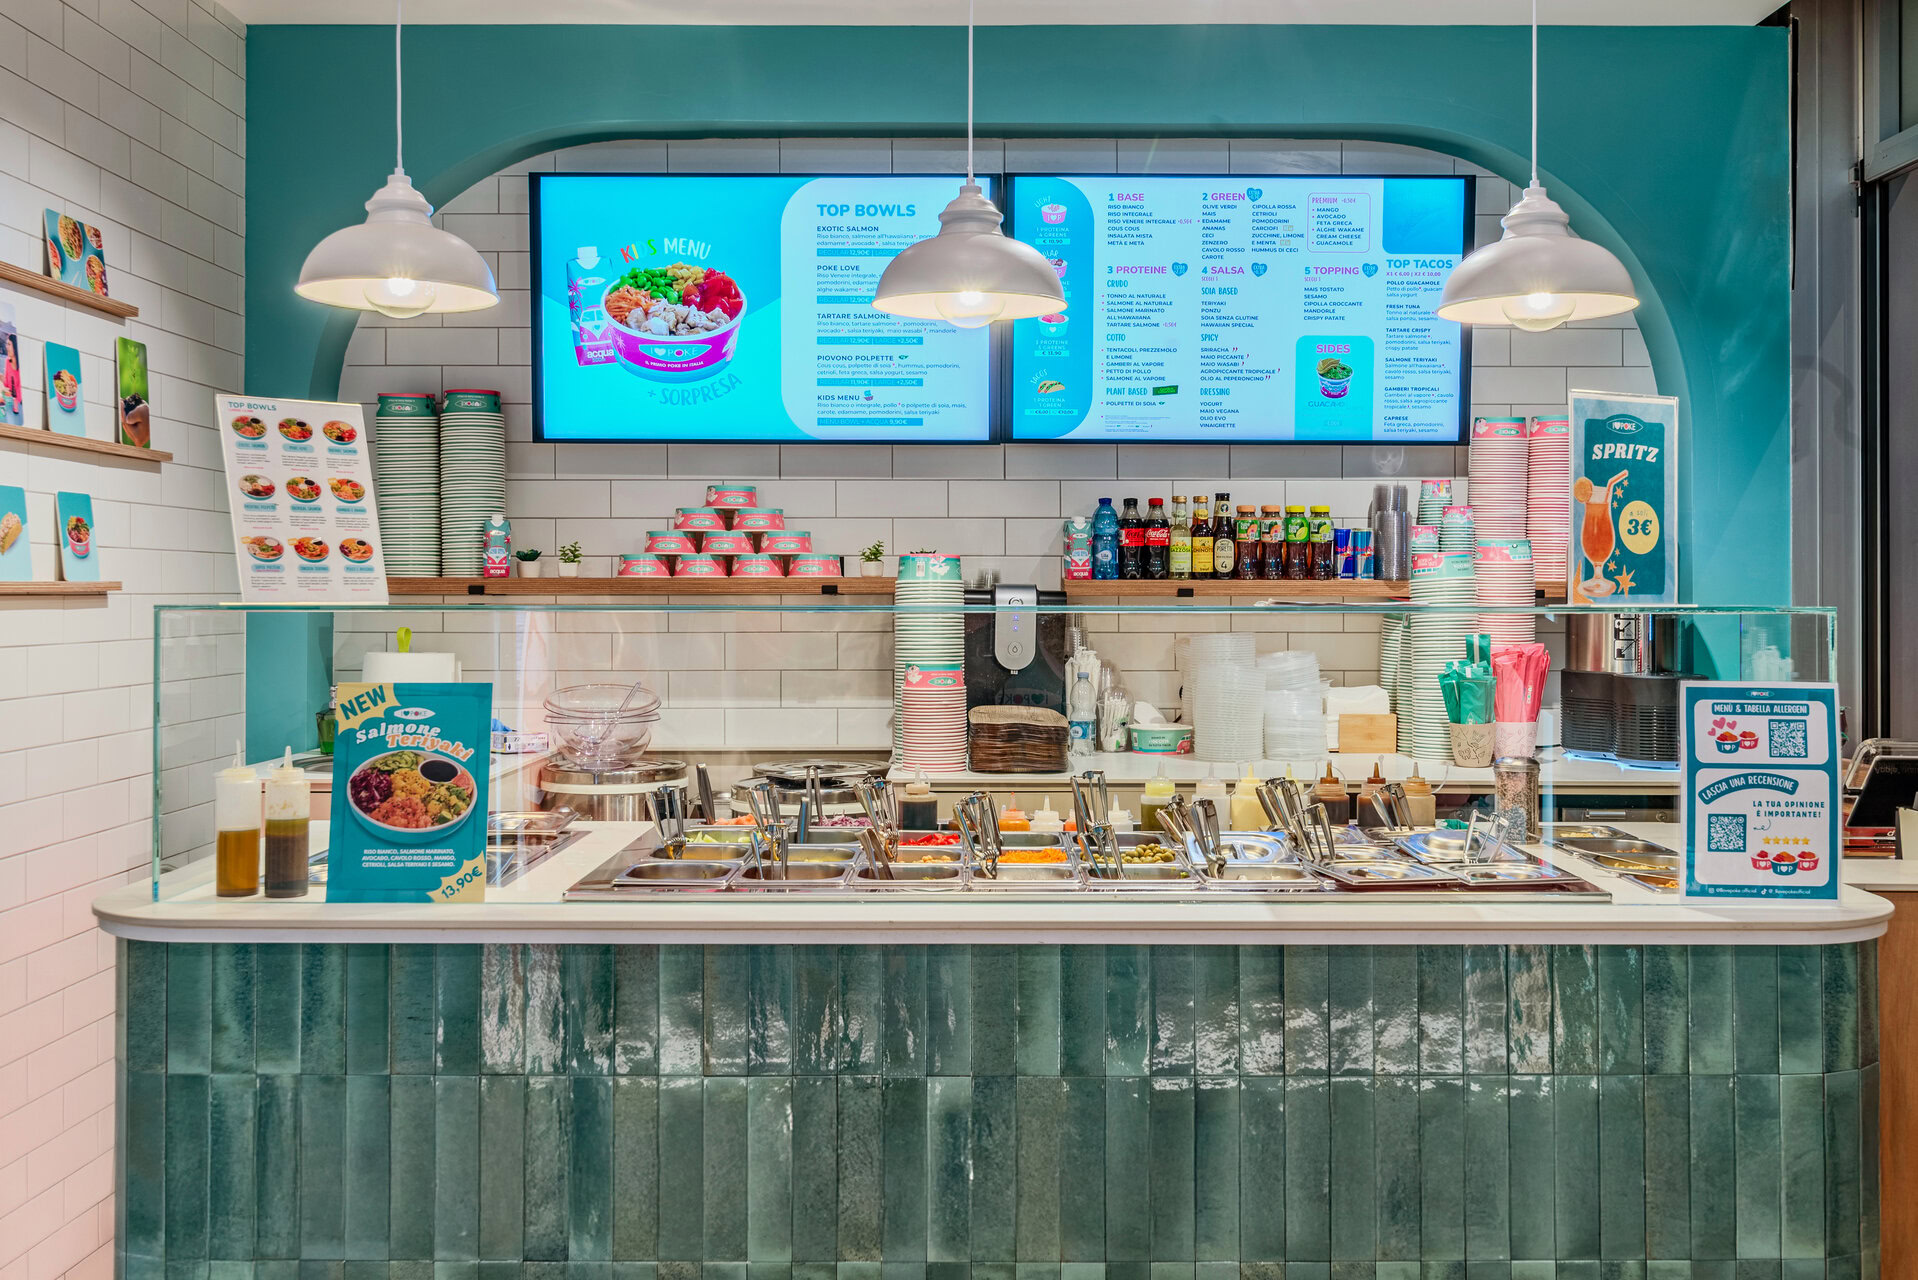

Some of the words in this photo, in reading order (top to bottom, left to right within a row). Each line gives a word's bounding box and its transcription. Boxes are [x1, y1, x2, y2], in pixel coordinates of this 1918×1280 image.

[1108, 193, 1115, 202] 1
[1117, 193, 1144, 202] BASE
[1202, 192, 1208, 201] 2
[1211, 192, 1246, 201] GREEN
[816, 204, 850, 217] TOP
[854, 204, 916, 217] BOWLS
[664, 238, 712, 260] MENU
[1386, 259, 1410, 269] TOP
[1412, 259, 1453, 269] TACOS
[1107, 266, 1114, 274] 3
[1116, 266, 1167, 274] PROTEINE
[1201, 266, 1208, 274] 4
[1210, 266, 1245, 274] SALSA
[1304, 266, 1311, 275] 5
[1313, 266, 1359, 275] TOPPING
[1106, 280, 1129, 288] CRUDO
[1201, 287, 1216, 295] SOIA
[1218, 287, 1238, 295] BASED
[1200, 334, 1219, 342] SPICY
[1315, 344, 1350, 354] SIDES
[586, 350, 614, 360] acqua
[659, 372, 743, 406] SORPRESA
[1106, 388, 1126, 396] PLANT
[1127, 388, 1148, 396] BASED
[1200, 388, 1230, 396] DRESSING
[247, 403, 277, 411] BOWLS
[1620, 423, 1636, 431] POKE
[1592, 443, 1660, 463] SPRITZ
[1626, 518, 1652, 536] 3€
[340, 684, 388, 720] NEW
[1714, 702, 1733, 712] MENÙ
[1744, 704, 1770, 713] TABELLA
[1773, 705, 1807, 714] ALLERGENI
[356, 722, 441, 744] Salmone
[386, 732, 475, 762] Teriyaki
[1702, 783, 1728, 800] LASCIA
[1730, 778, 1746, 788] UNA
[1748, 776, 1795, 791] RECENSIONE
[441, 866, 482, 898] 13,90€
